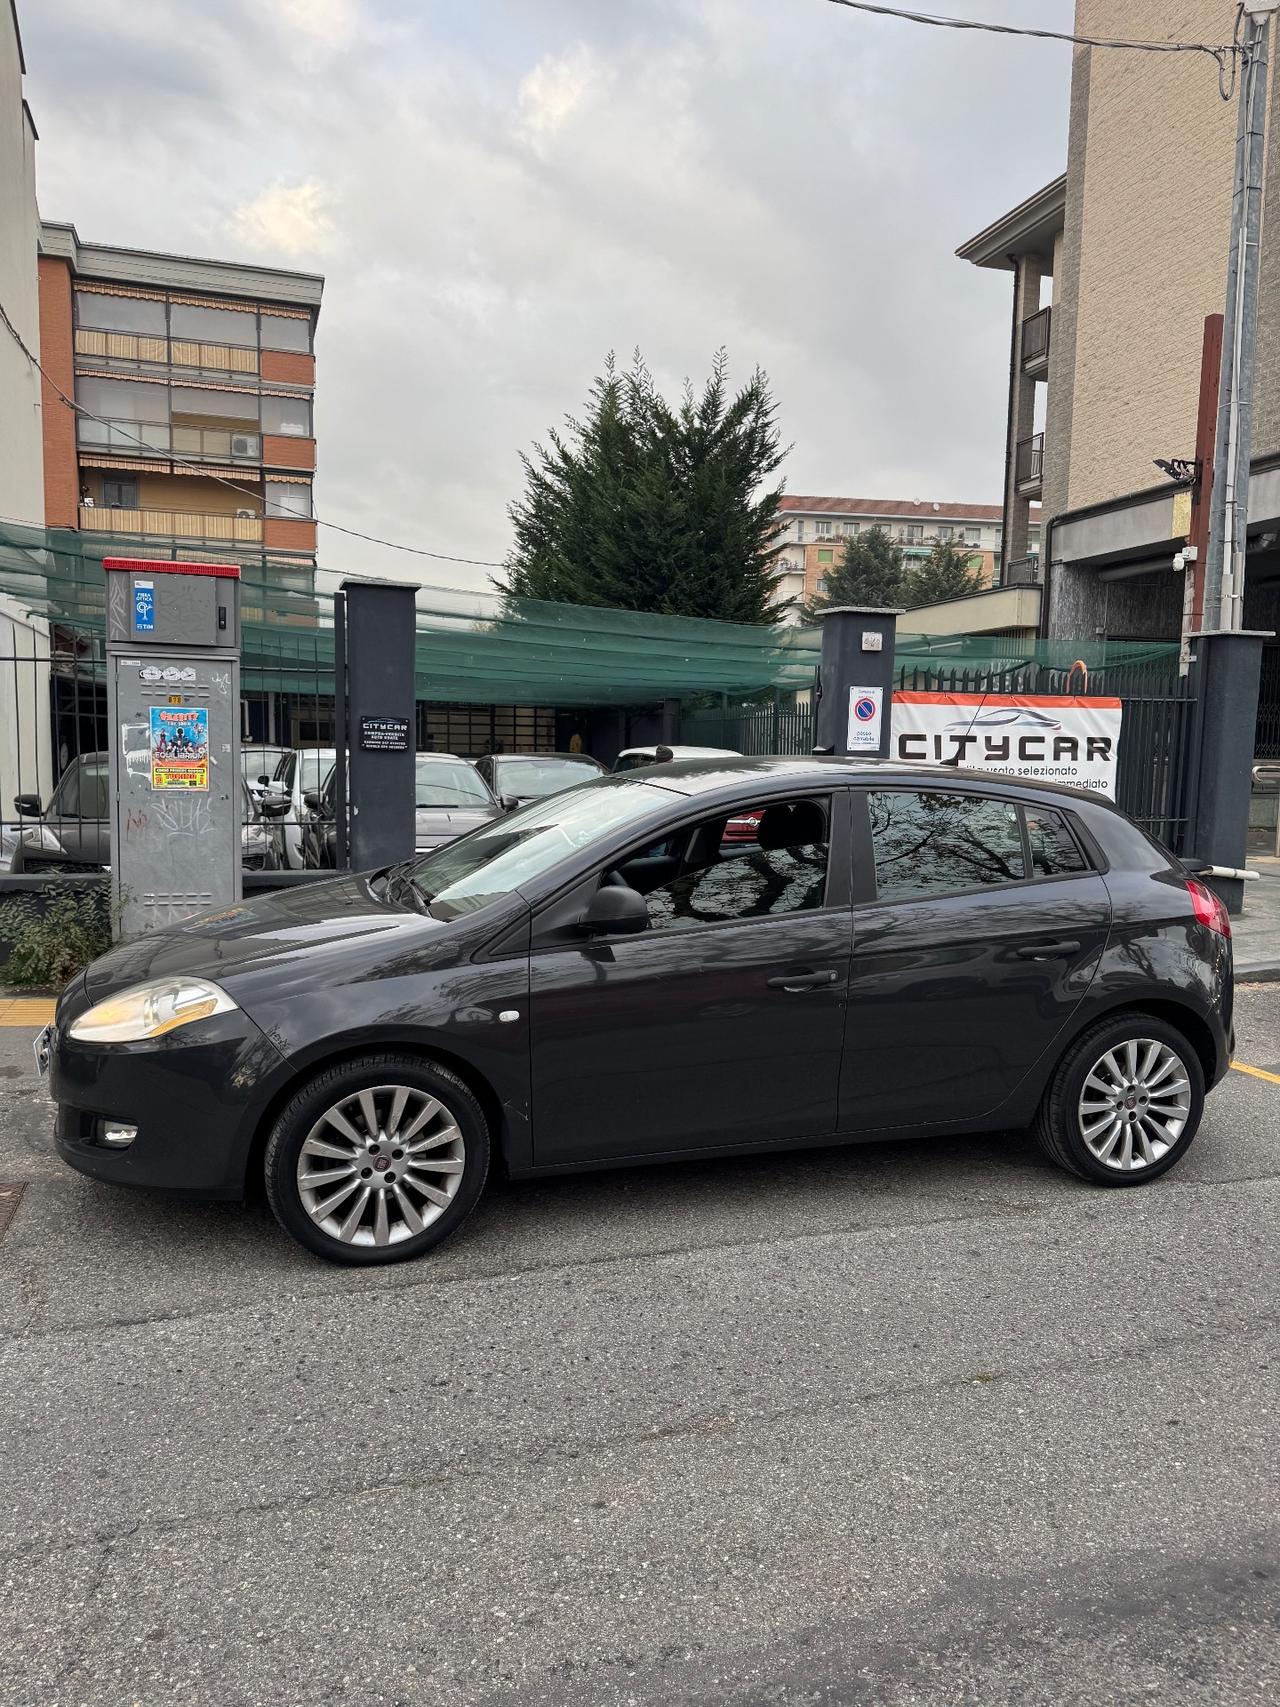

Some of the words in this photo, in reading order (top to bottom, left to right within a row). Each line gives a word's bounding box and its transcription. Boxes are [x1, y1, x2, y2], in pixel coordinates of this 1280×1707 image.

[362, 723, 408, 731] CITYCAR
[898, 733, 1112, 762] CITYCAR
[1017, 765, 1078, 776] selezionato
